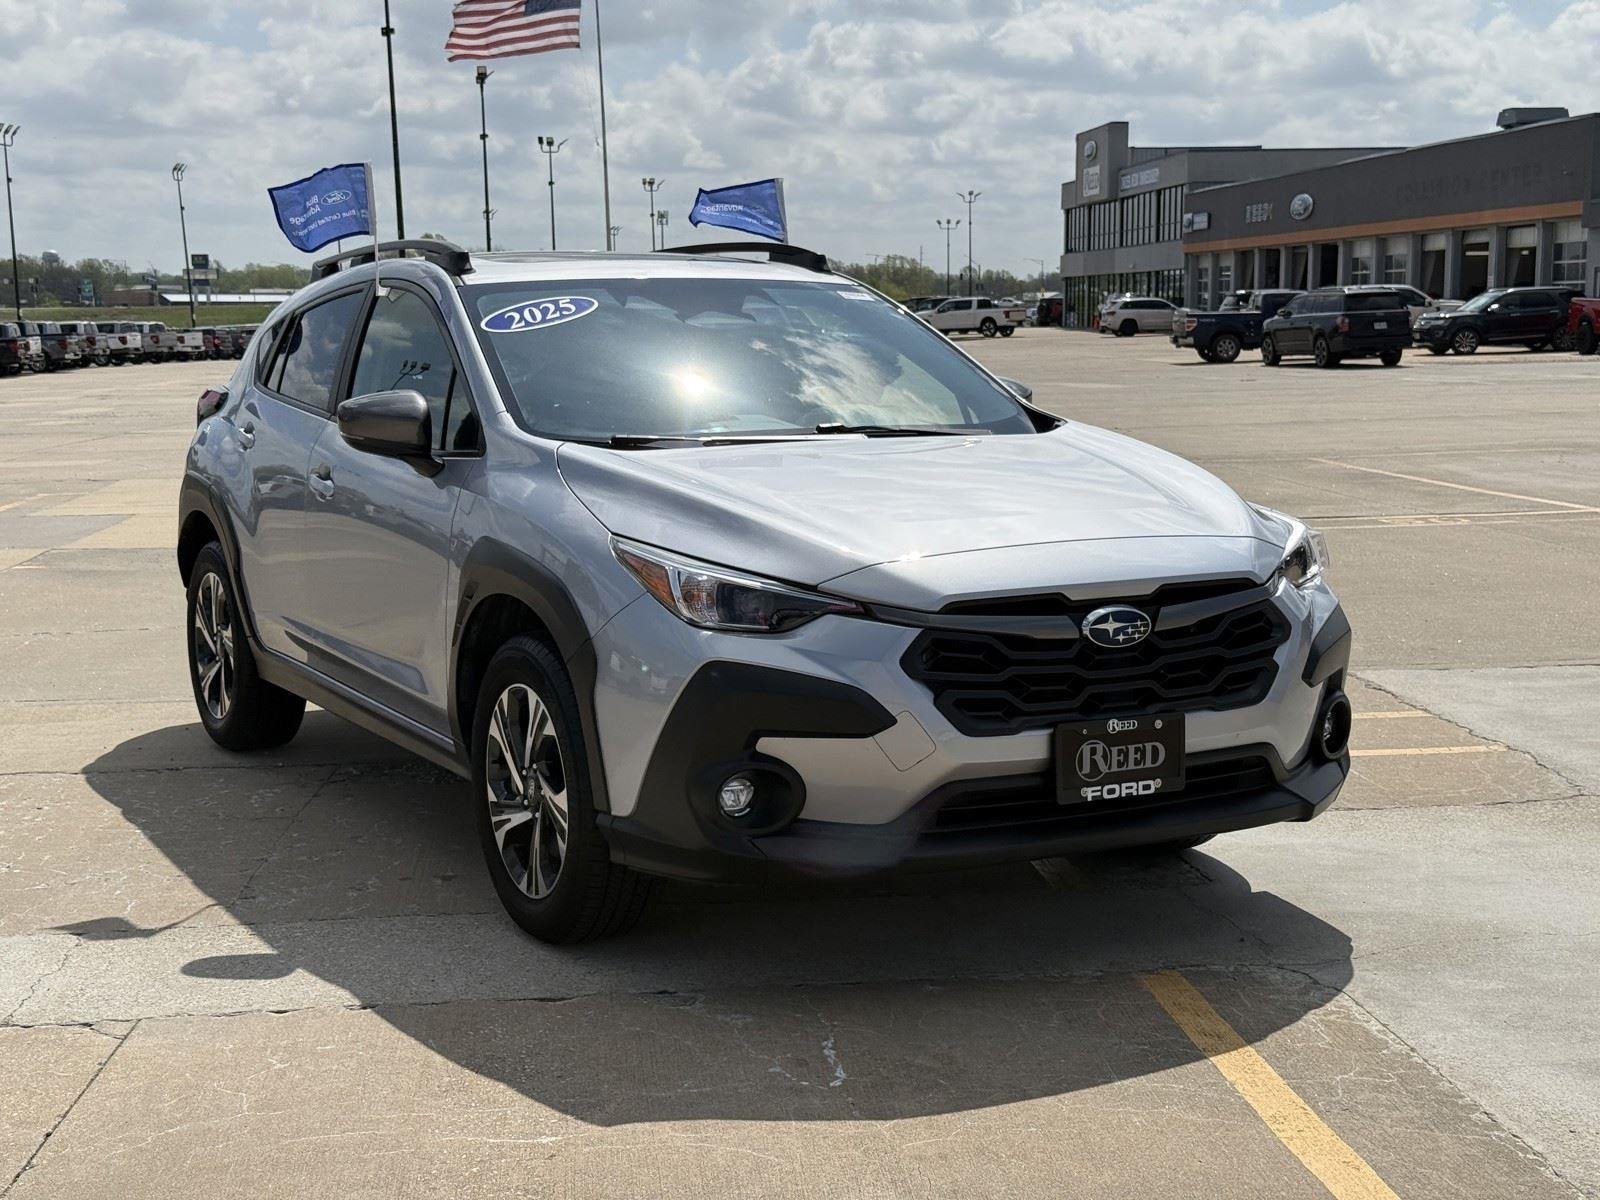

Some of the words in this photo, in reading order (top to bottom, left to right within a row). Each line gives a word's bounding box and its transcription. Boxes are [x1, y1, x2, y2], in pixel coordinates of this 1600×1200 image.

[504, 298, 577, 330] 2025
[1077, 740, 1166, 778] REED
[1087, 780, 1157, 801] FORD
